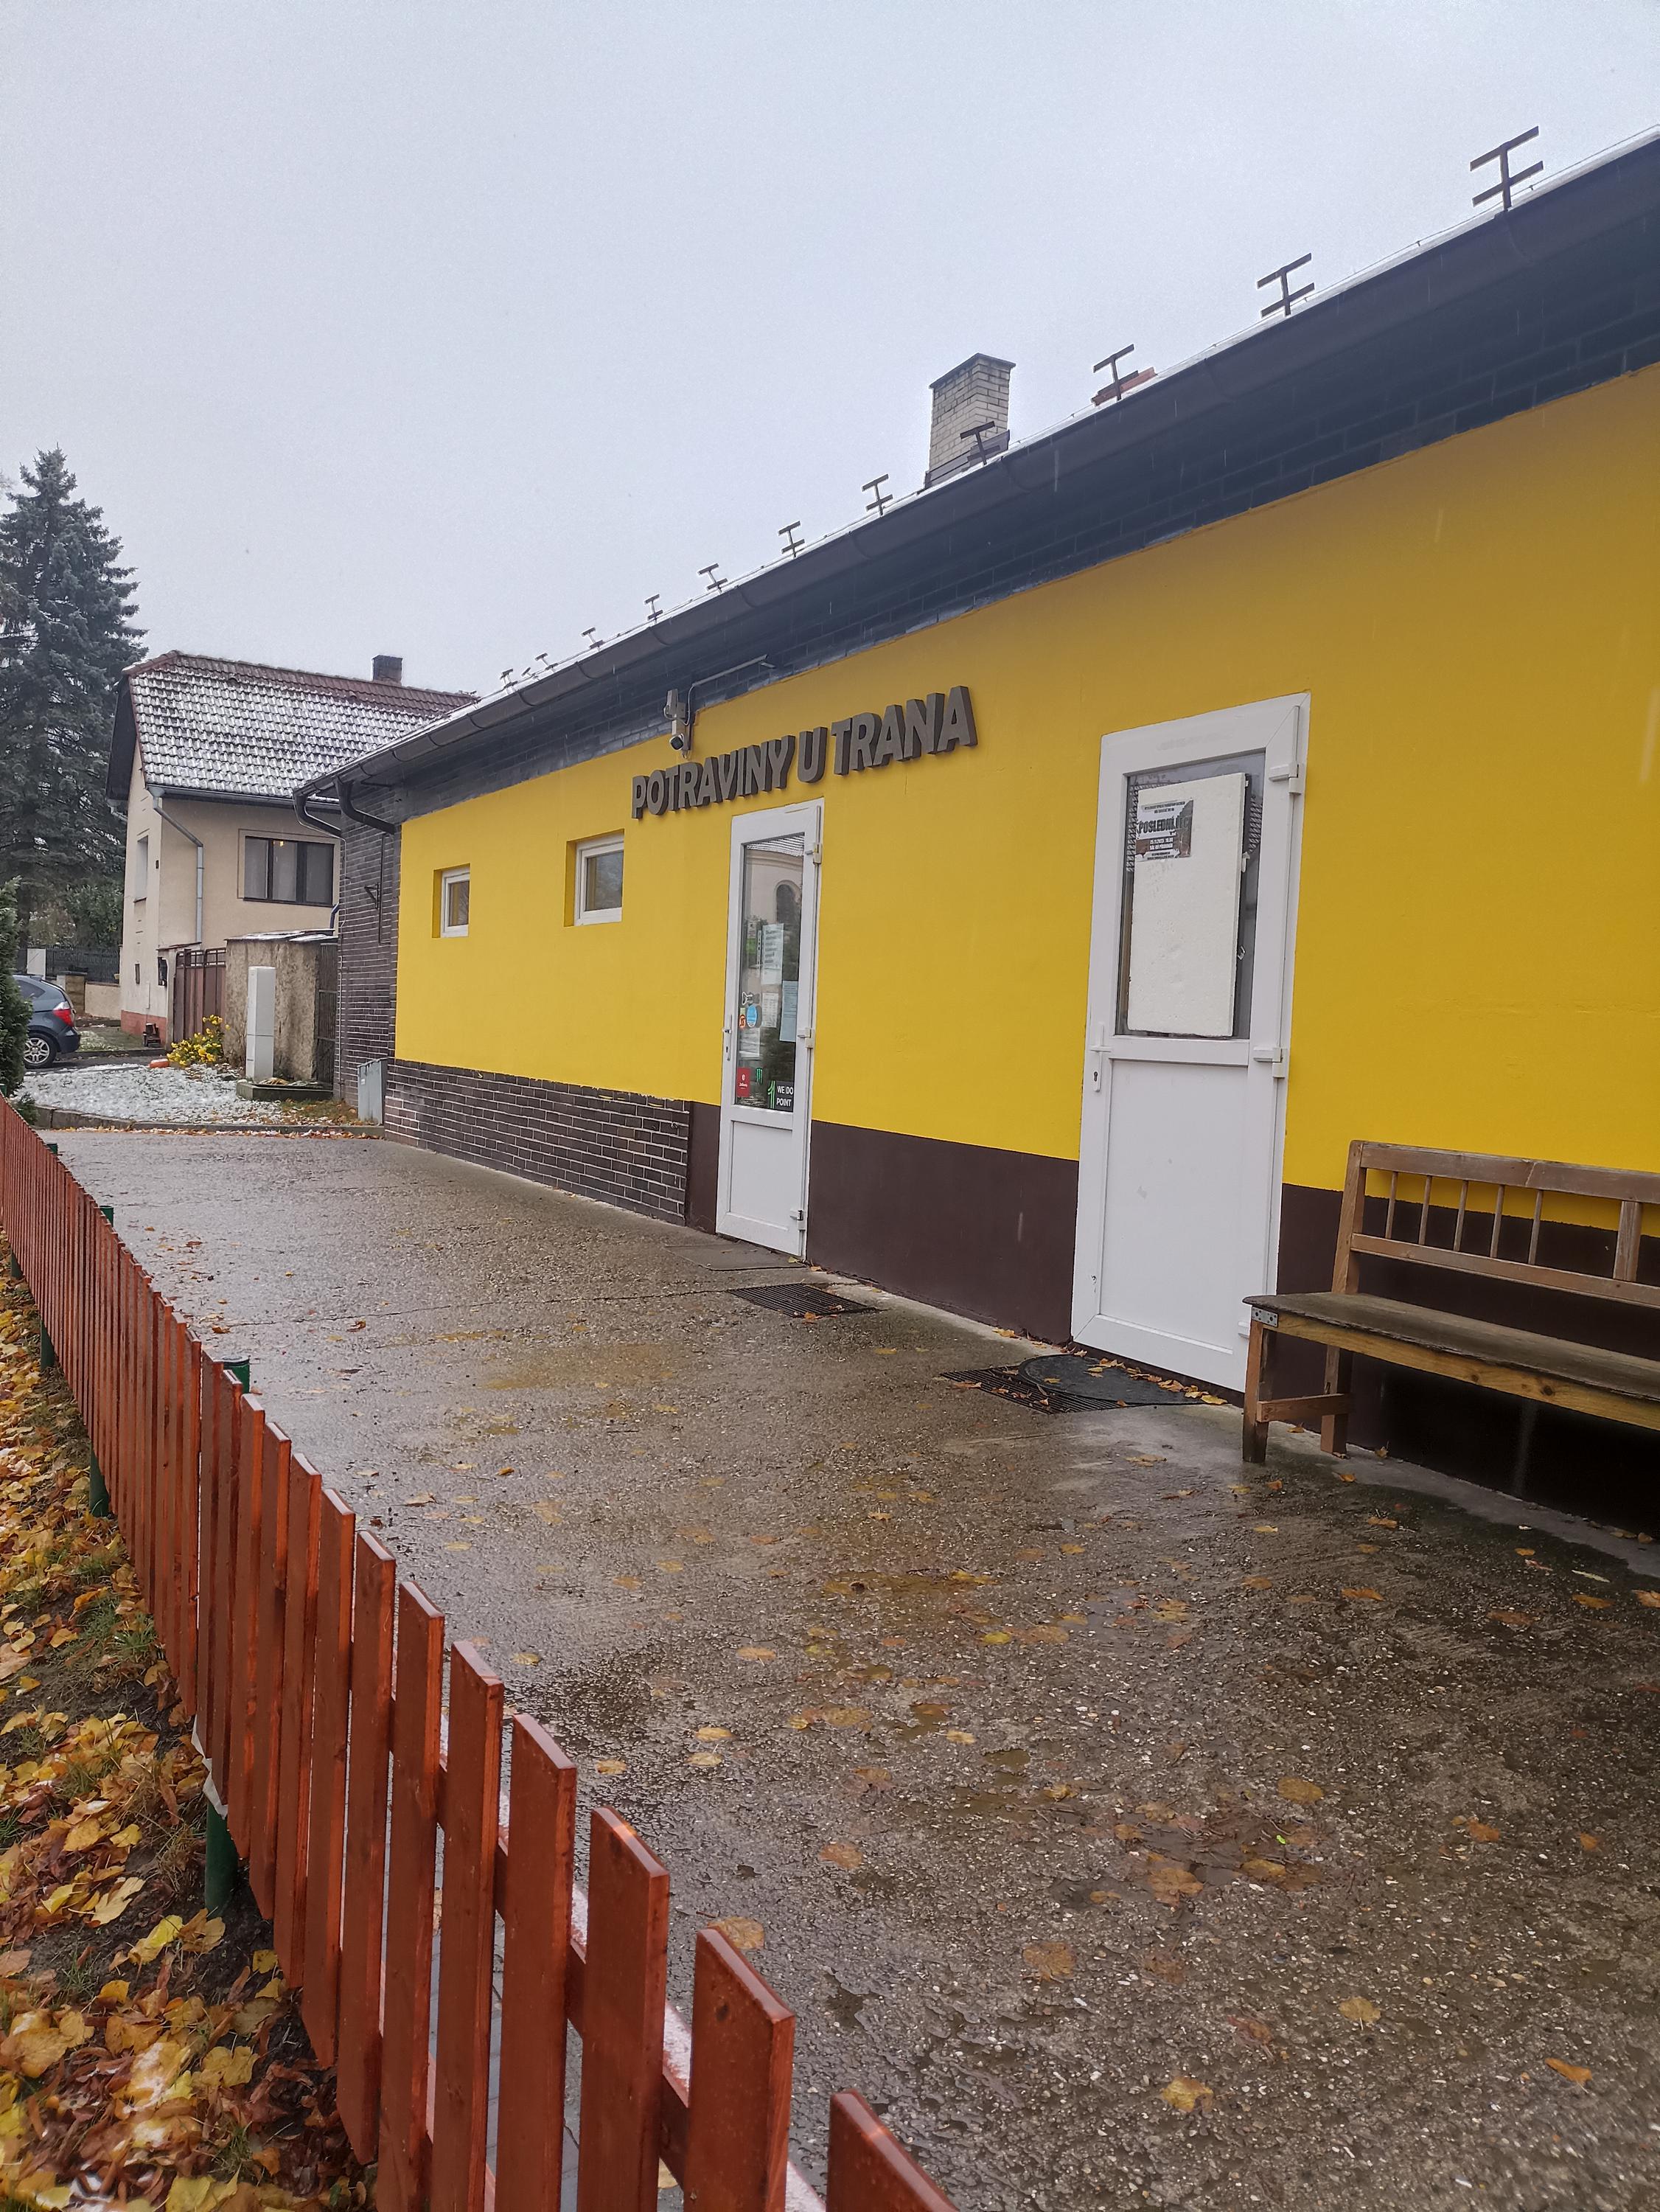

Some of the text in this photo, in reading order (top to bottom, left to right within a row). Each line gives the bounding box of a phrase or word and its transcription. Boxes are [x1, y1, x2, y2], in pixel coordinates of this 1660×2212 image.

[632, 686, 977, 819] POTRAVINY U TRANA
[777, 1085, 793, 1095] WE DO
[776, 1097, 791, 1107] POINT
